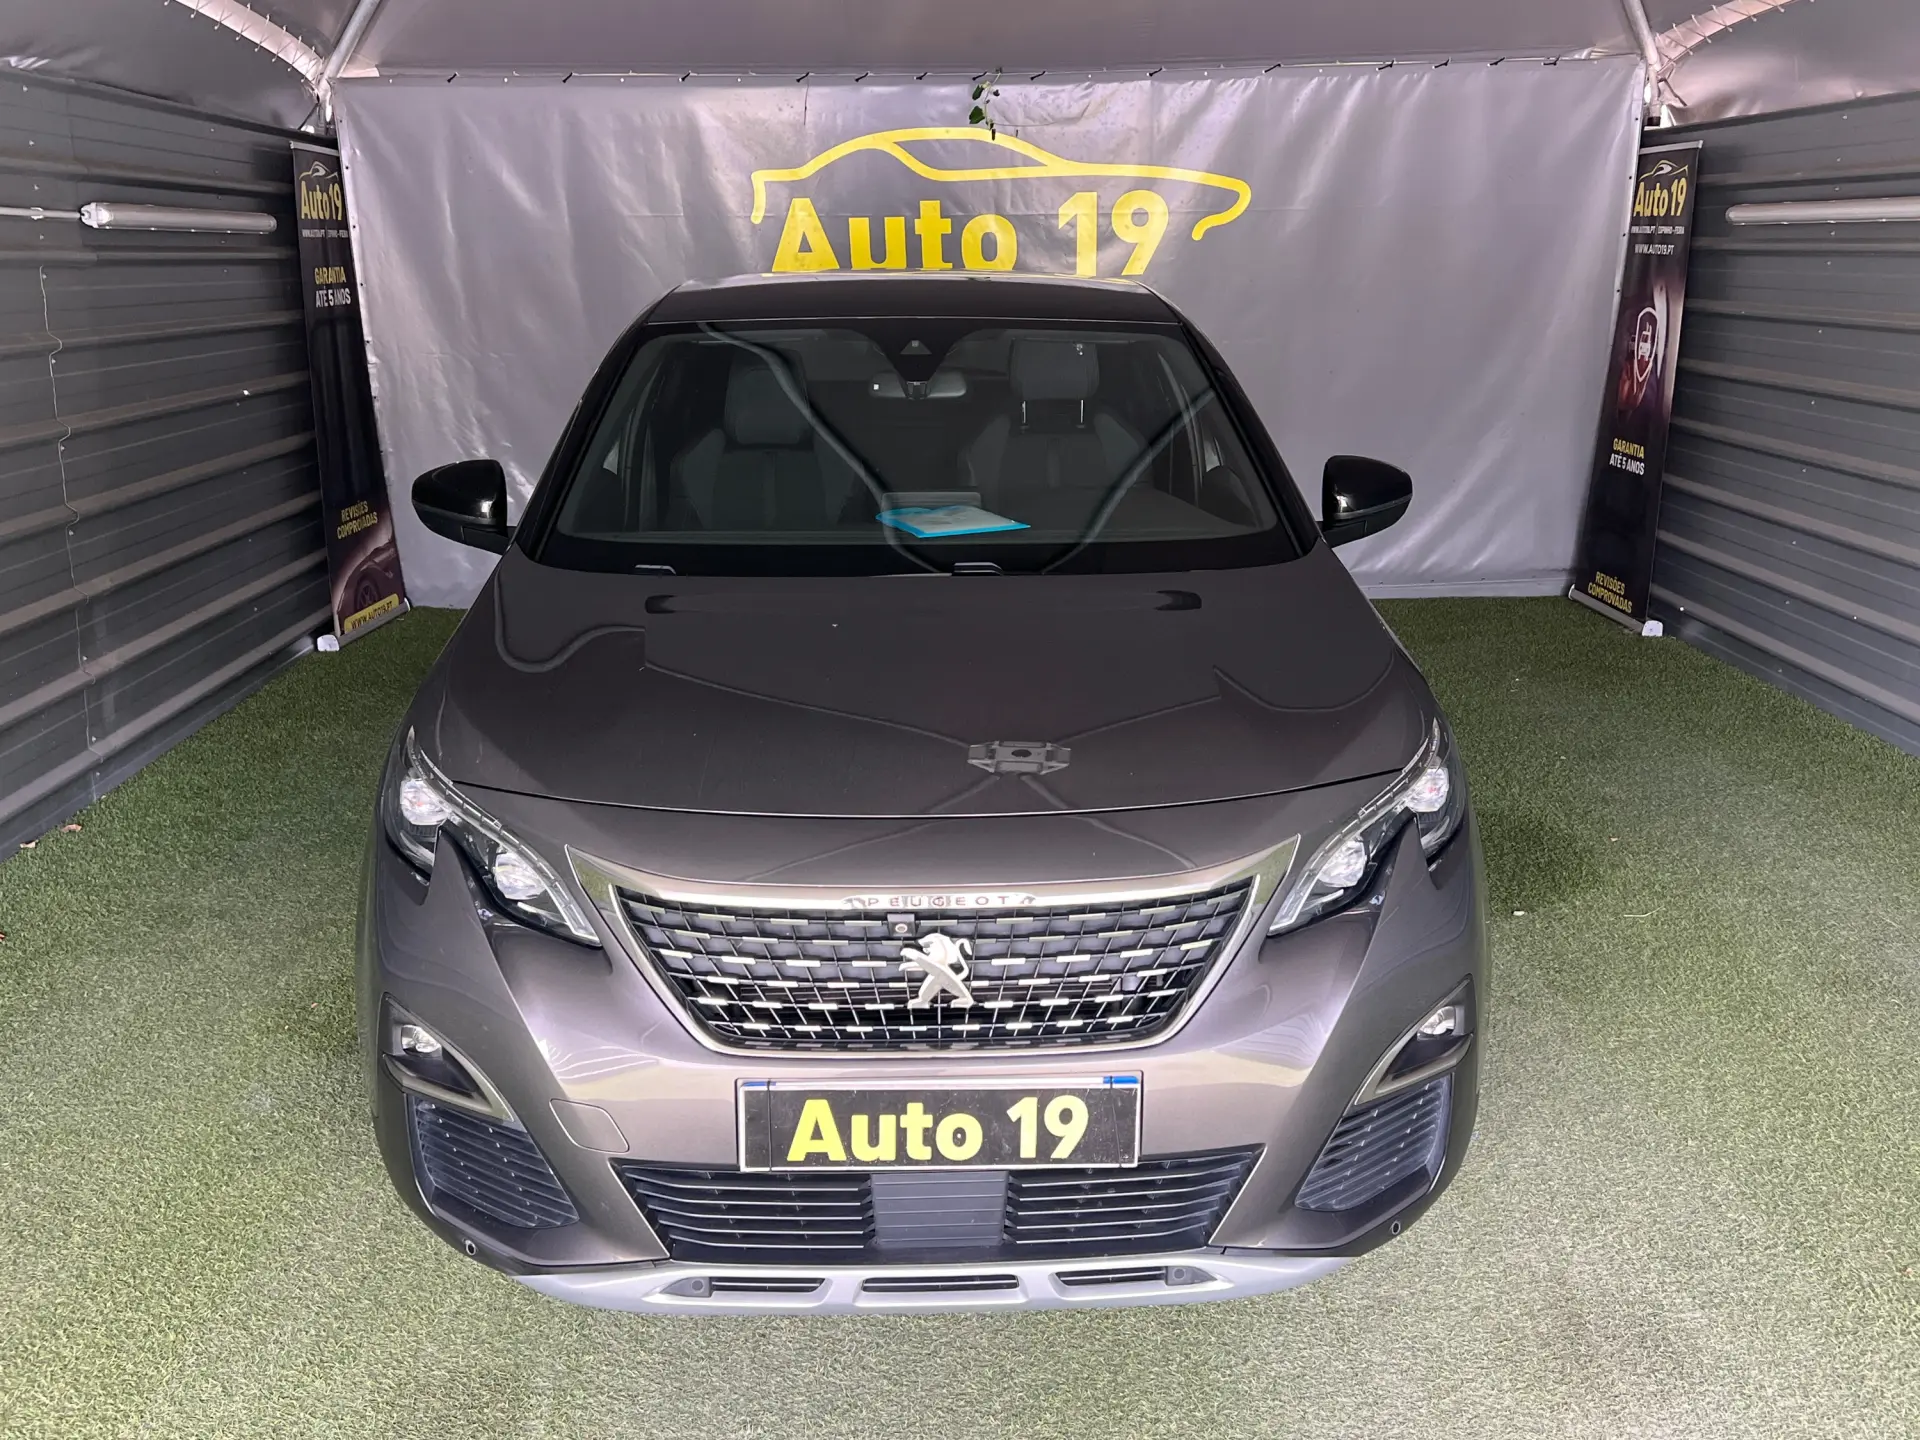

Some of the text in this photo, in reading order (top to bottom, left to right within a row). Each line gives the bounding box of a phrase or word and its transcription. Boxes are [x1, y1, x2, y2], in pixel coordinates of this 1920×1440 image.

[1633, 177, 1687, 217] Auto 19
[771, 189, 1169, 276] Auto 19
[1634, 243, 1675, 255] WWW.AUTO19.PT
[314, 266, 347, 285] GARANTIA
[315, 285, 351, 308] ATÉ 5 ANOS
[1613, 437, 1645, 459] GARANTIA
[1609, 452, 1645, 475] ATÉ 5 ANOS
[1595, 571, 1626, 596] REVISÕES
[1587, 582, 1633, 613] COMPROVADAS
[867, 895, 1010, 908] PEUGEOT
[786, 1094, 1089, 1162] Auto 19
